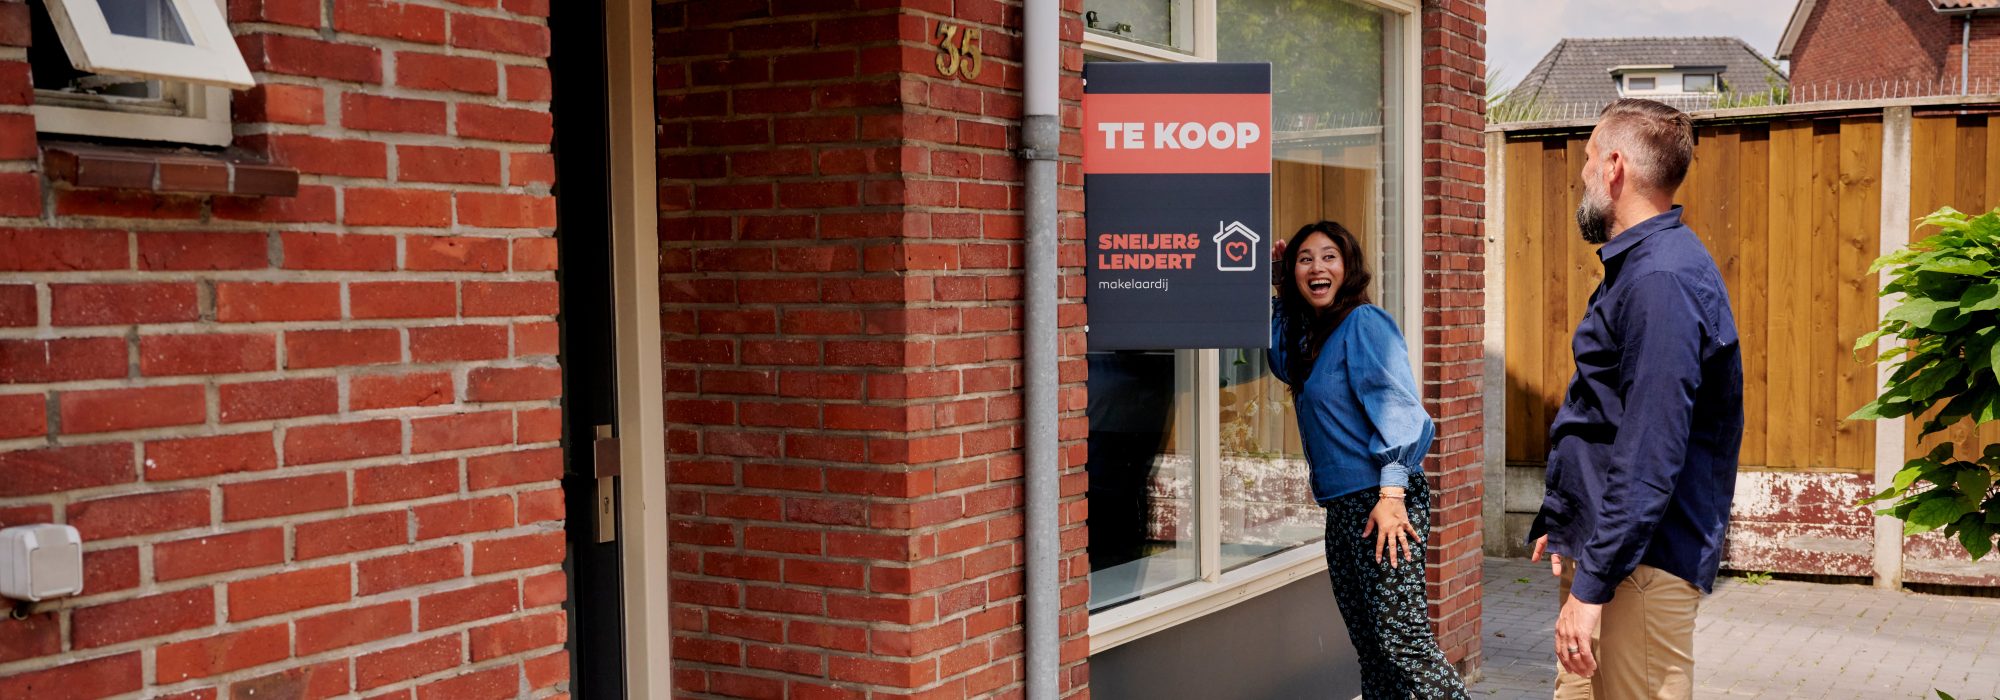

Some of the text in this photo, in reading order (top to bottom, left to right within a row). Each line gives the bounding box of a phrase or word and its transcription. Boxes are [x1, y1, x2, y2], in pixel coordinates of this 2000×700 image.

[935, 20, 981, 80] 35
[1098, 121, 1261, 149] TE KOOP
[1098, 233, 1200, 250] SNEIJER&
[1098, 253, 1196, 270] LENDERT
[1098, 278, 1169, 292] makelaardij
